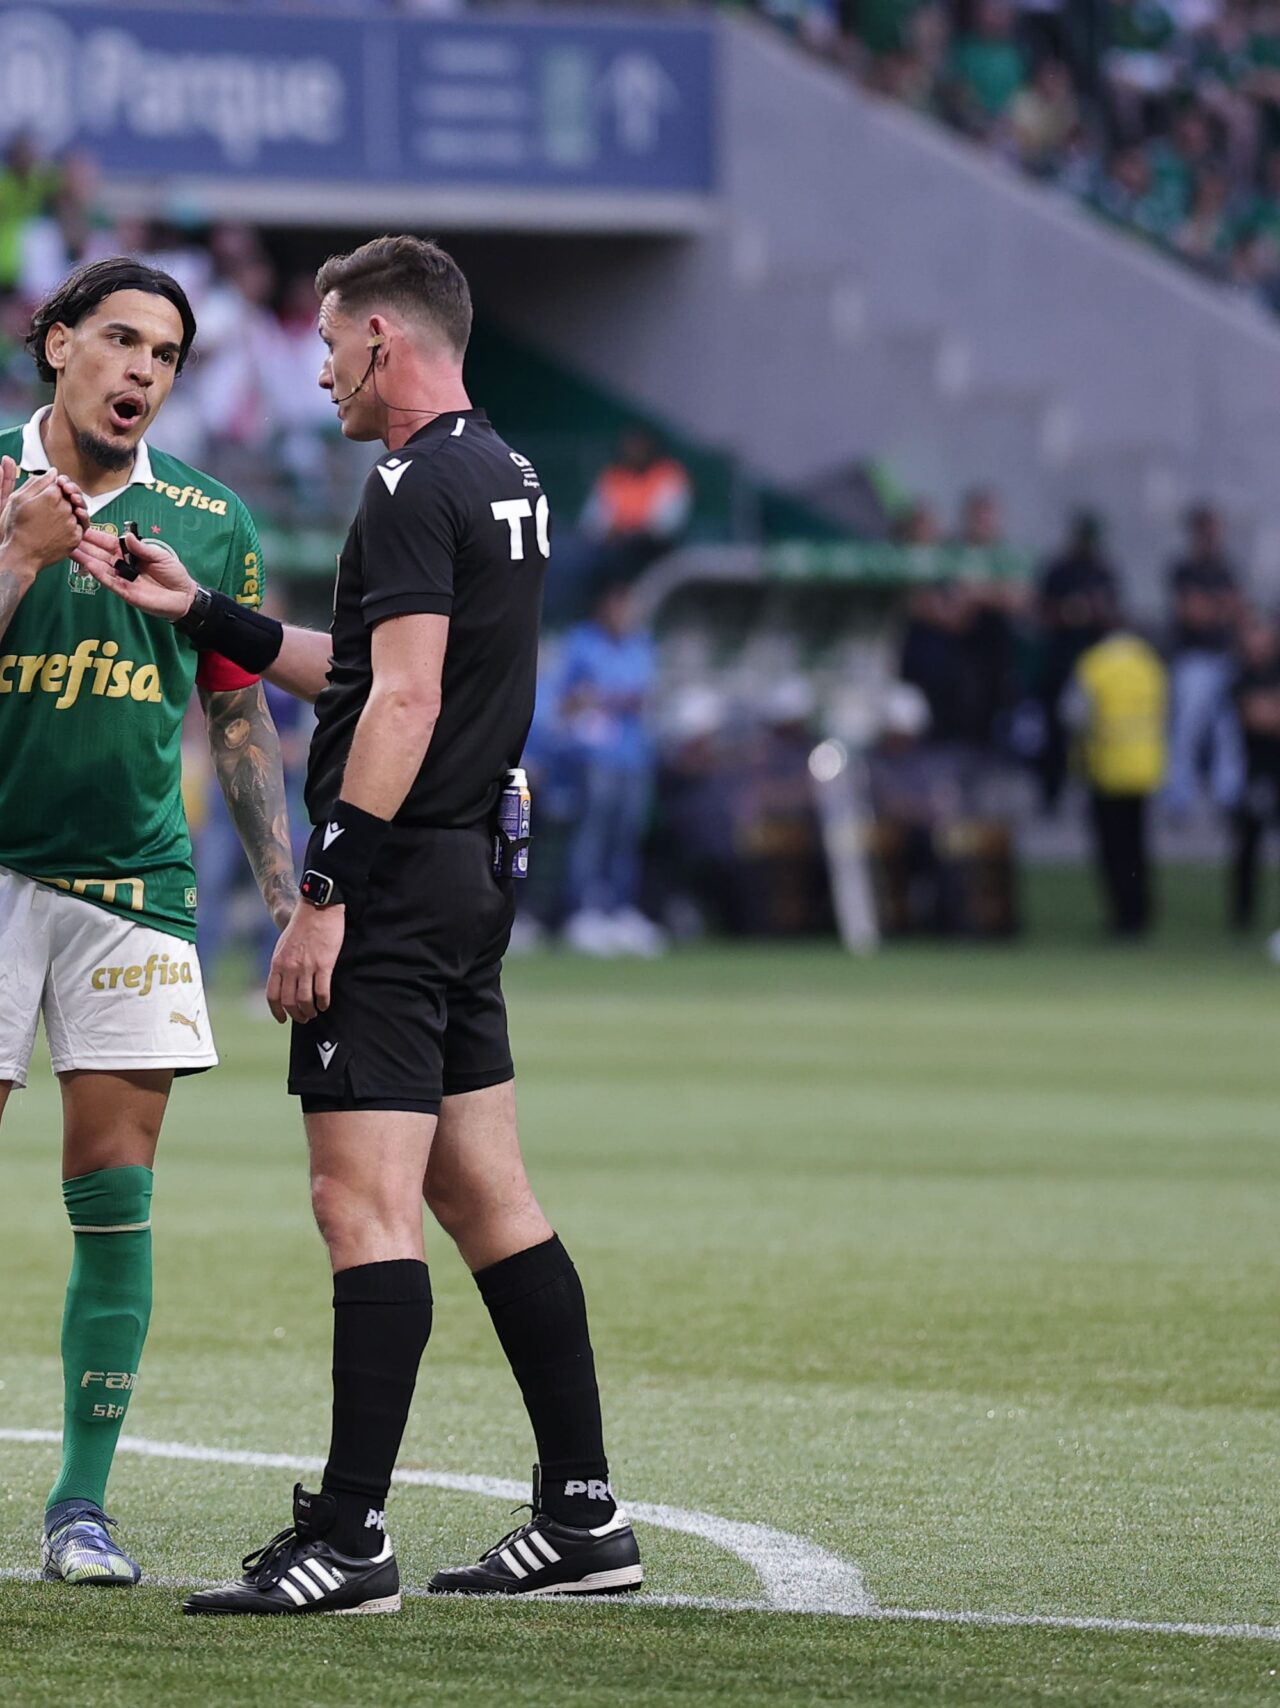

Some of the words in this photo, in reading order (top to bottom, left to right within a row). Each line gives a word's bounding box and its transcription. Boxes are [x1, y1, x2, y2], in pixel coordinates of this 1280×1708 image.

[235, 552, 261, 612] cref
[91, 953, 193, 997] crefisa
[92, 1403, 124, 1419] SEP
